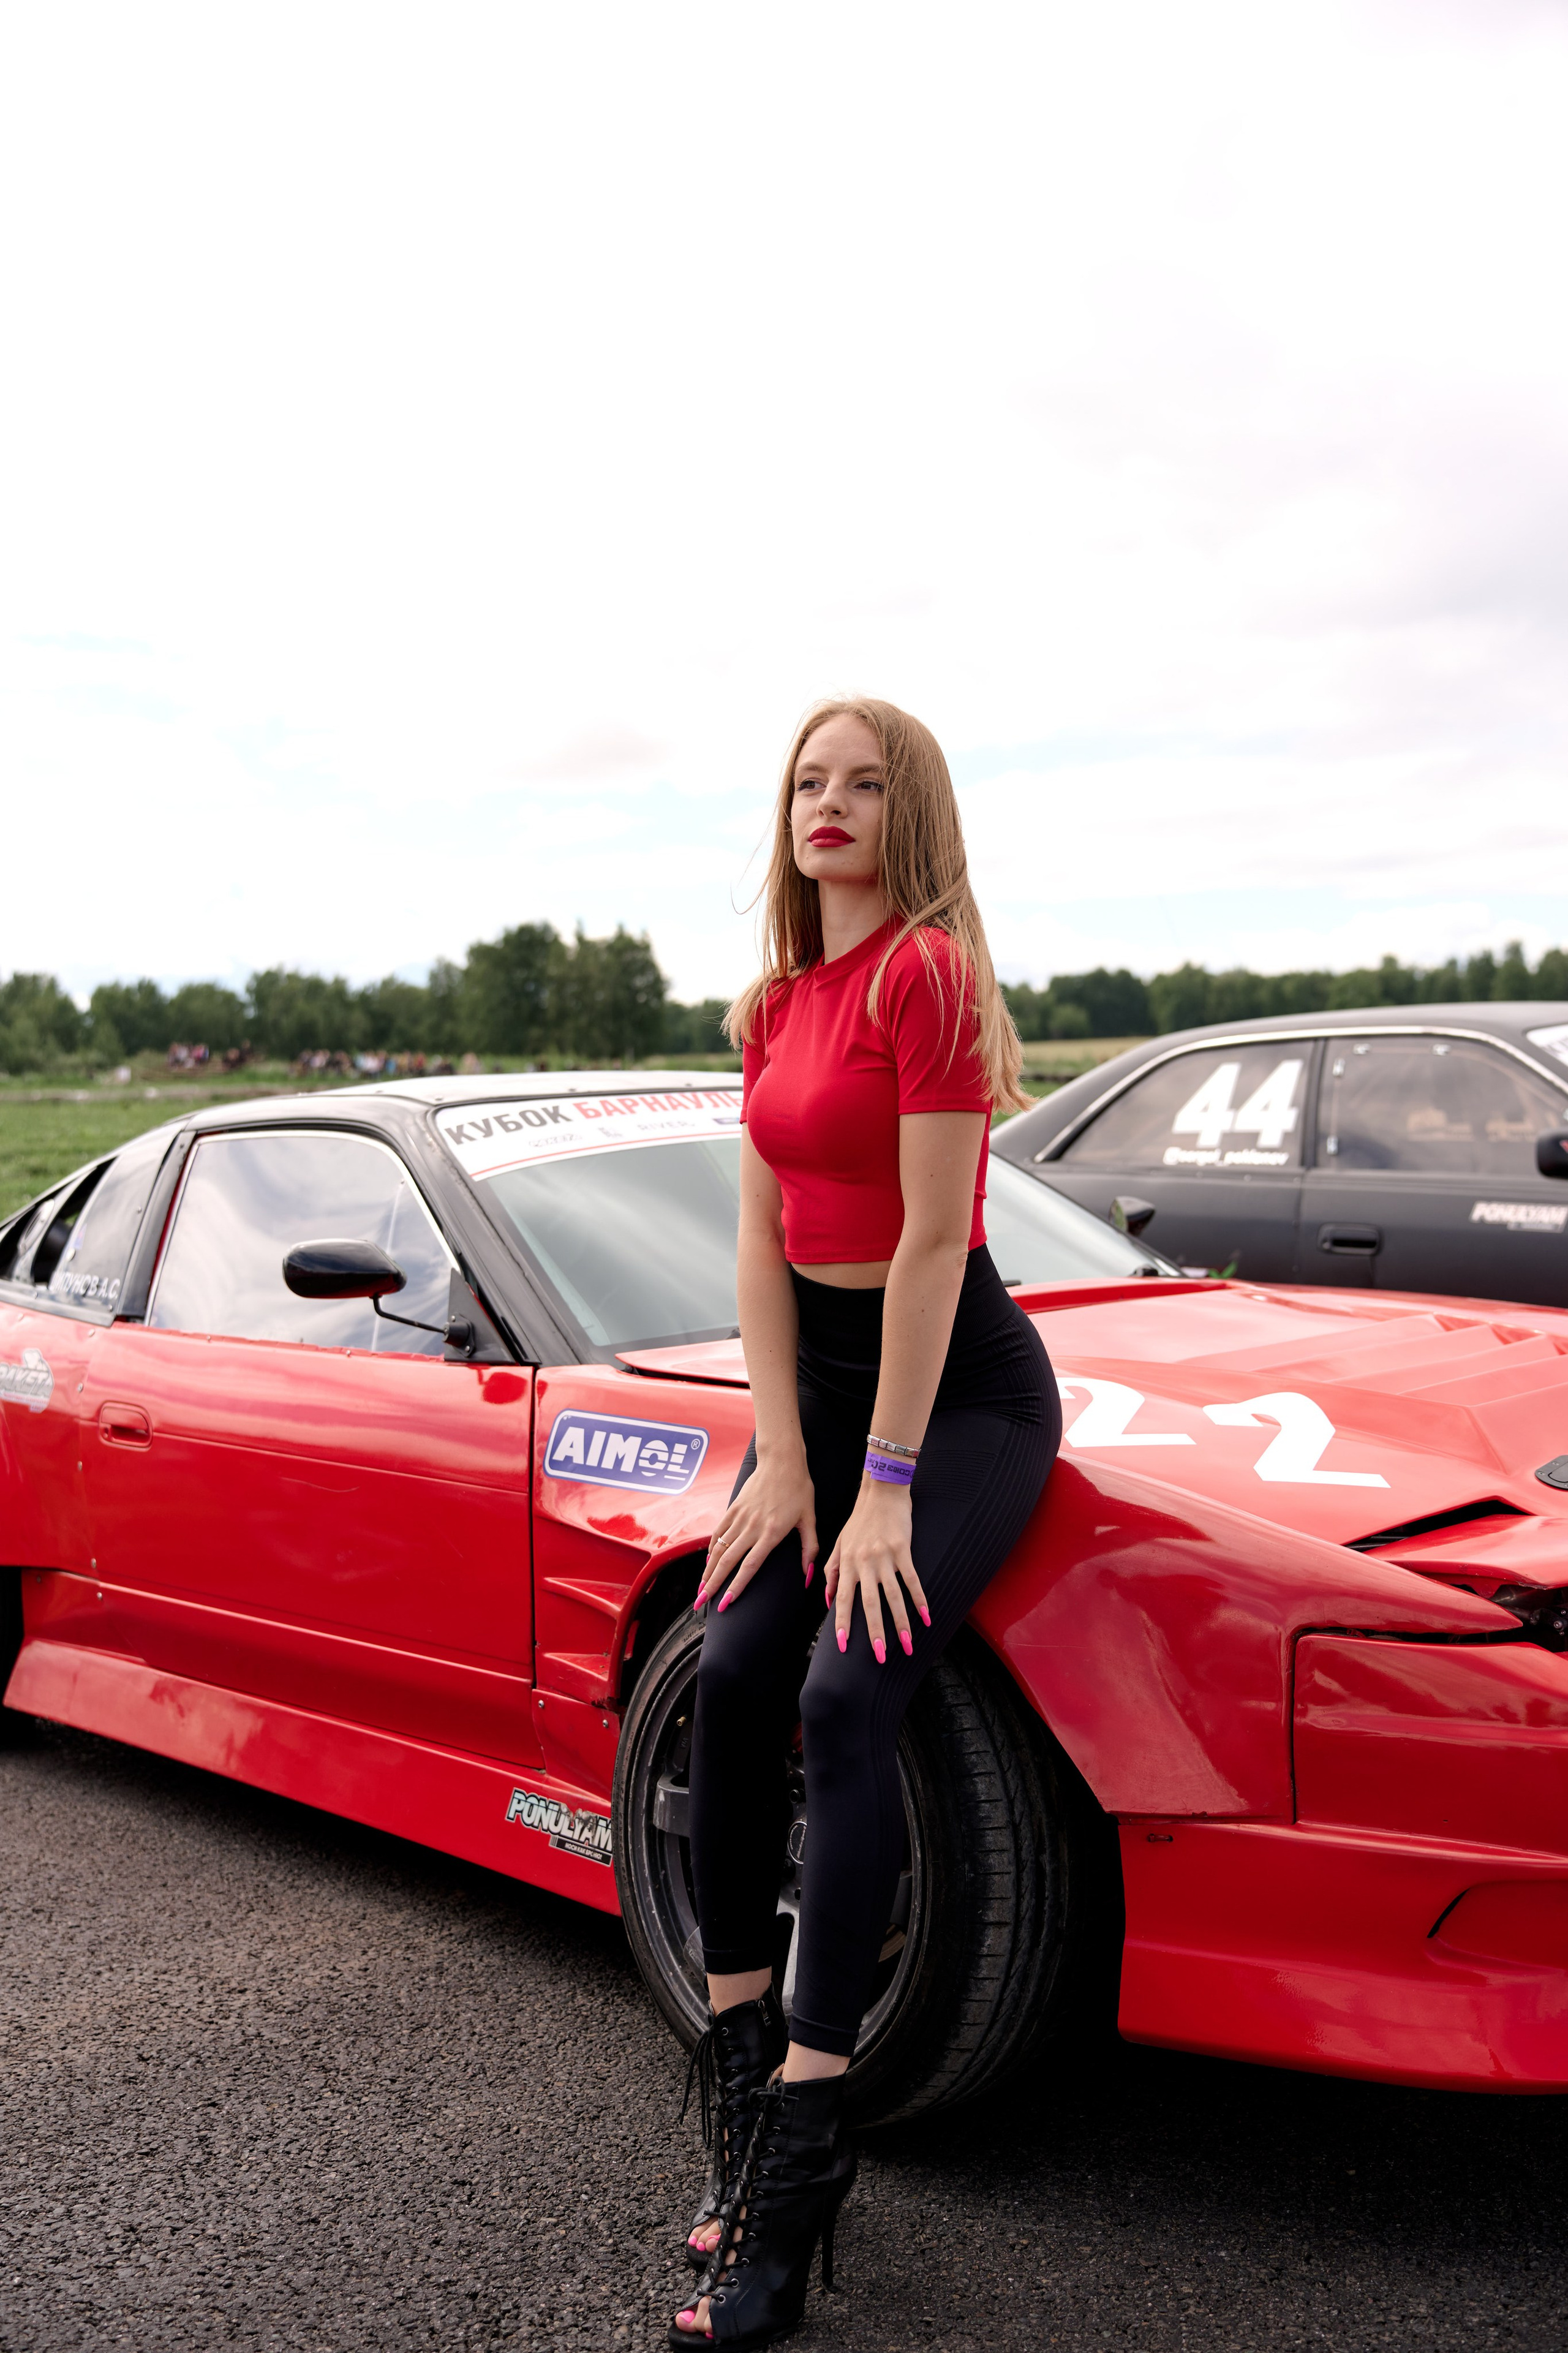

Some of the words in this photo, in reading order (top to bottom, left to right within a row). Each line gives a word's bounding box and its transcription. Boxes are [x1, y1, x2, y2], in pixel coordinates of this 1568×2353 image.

[444, 1105, 573, 1145] КУБОК
[1172, 1058, 1303, 1148] 44
[552, 1426, 690, 1481] AIMOL
[507, 1789, 612, 1853] PONULYAM
